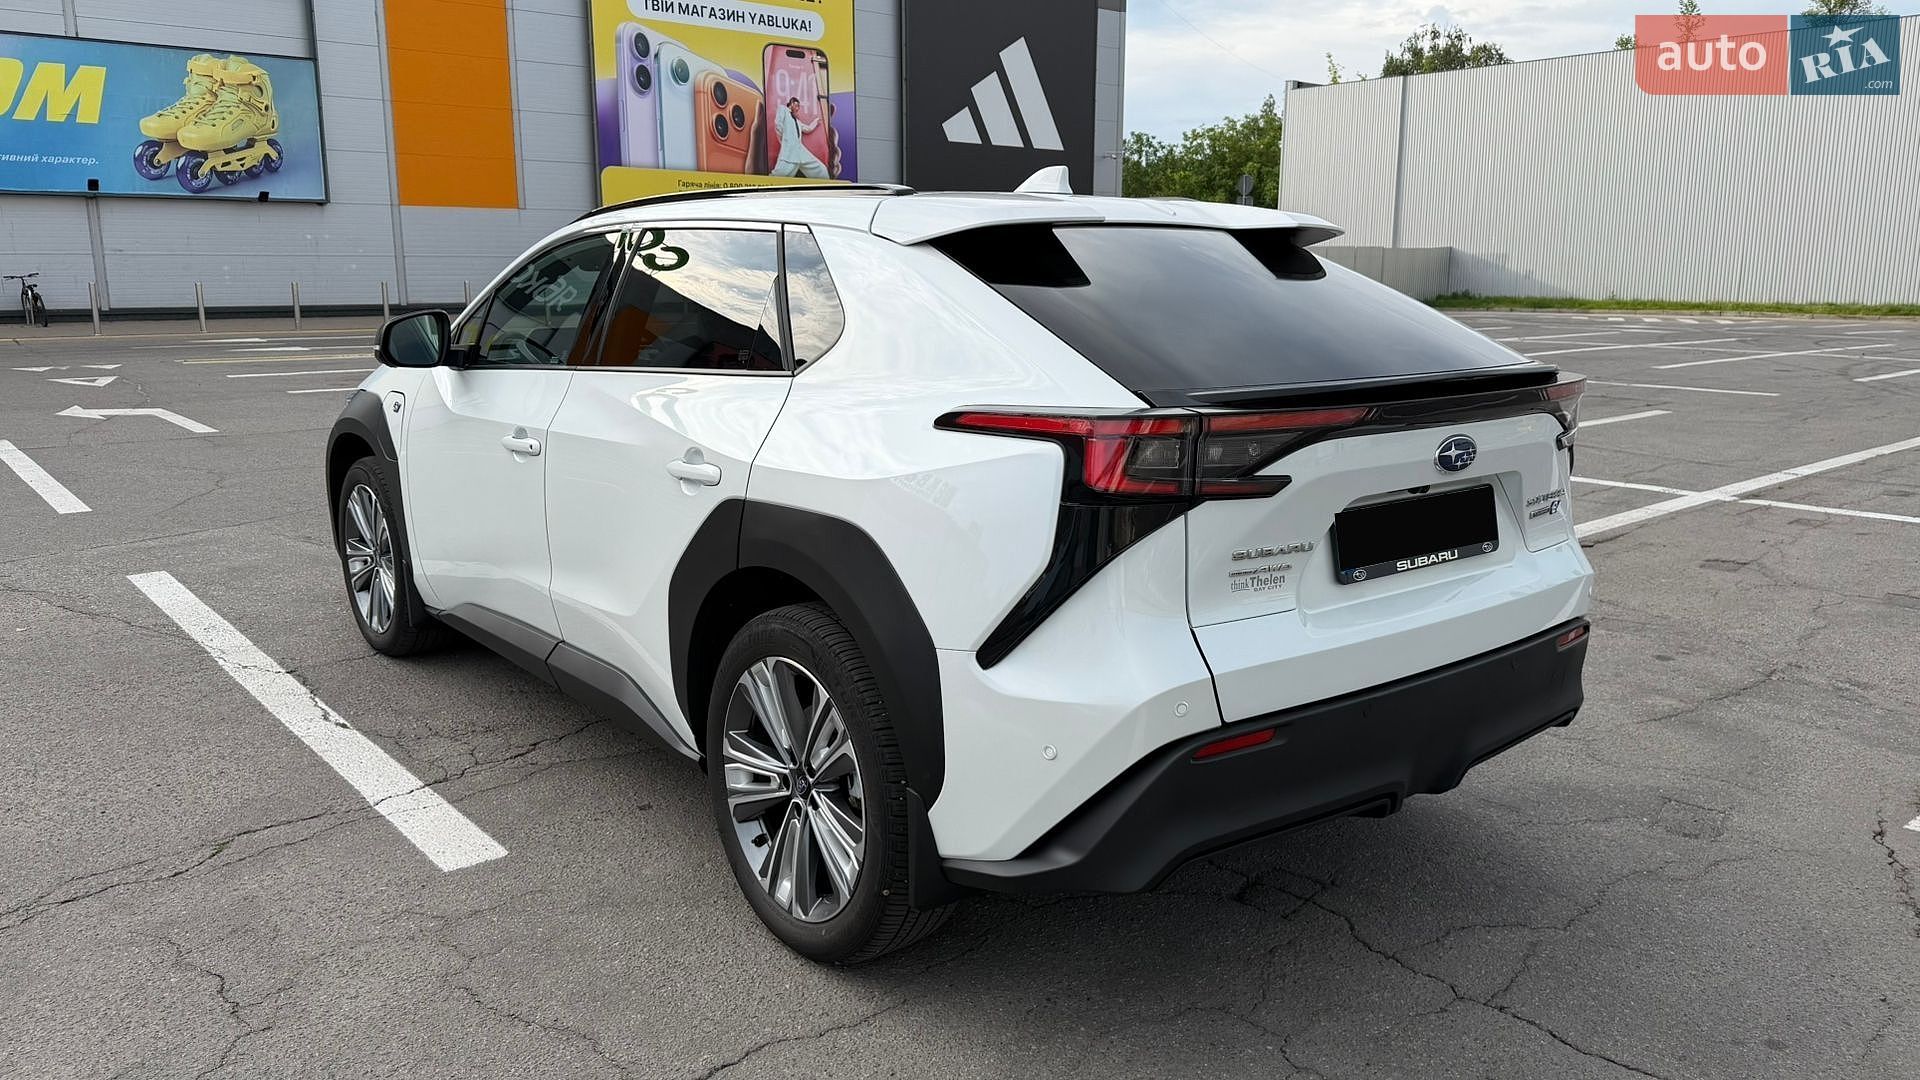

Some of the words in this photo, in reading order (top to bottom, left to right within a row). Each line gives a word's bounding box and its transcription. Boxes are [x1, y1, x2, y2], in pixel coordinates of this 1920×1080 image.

[678, 2, 745, 23] МАГАЗИН
[749, 11, 812, 32] YABLUKA!
[41, 155, 99, 165] характер.
[1231, 541, 1315, 561] SUBARU
[1396, 549, 1458, 571] SUBARU
[1230, 578, 1249, 592] think
[1250, 573, 1286, 588] Thelen
